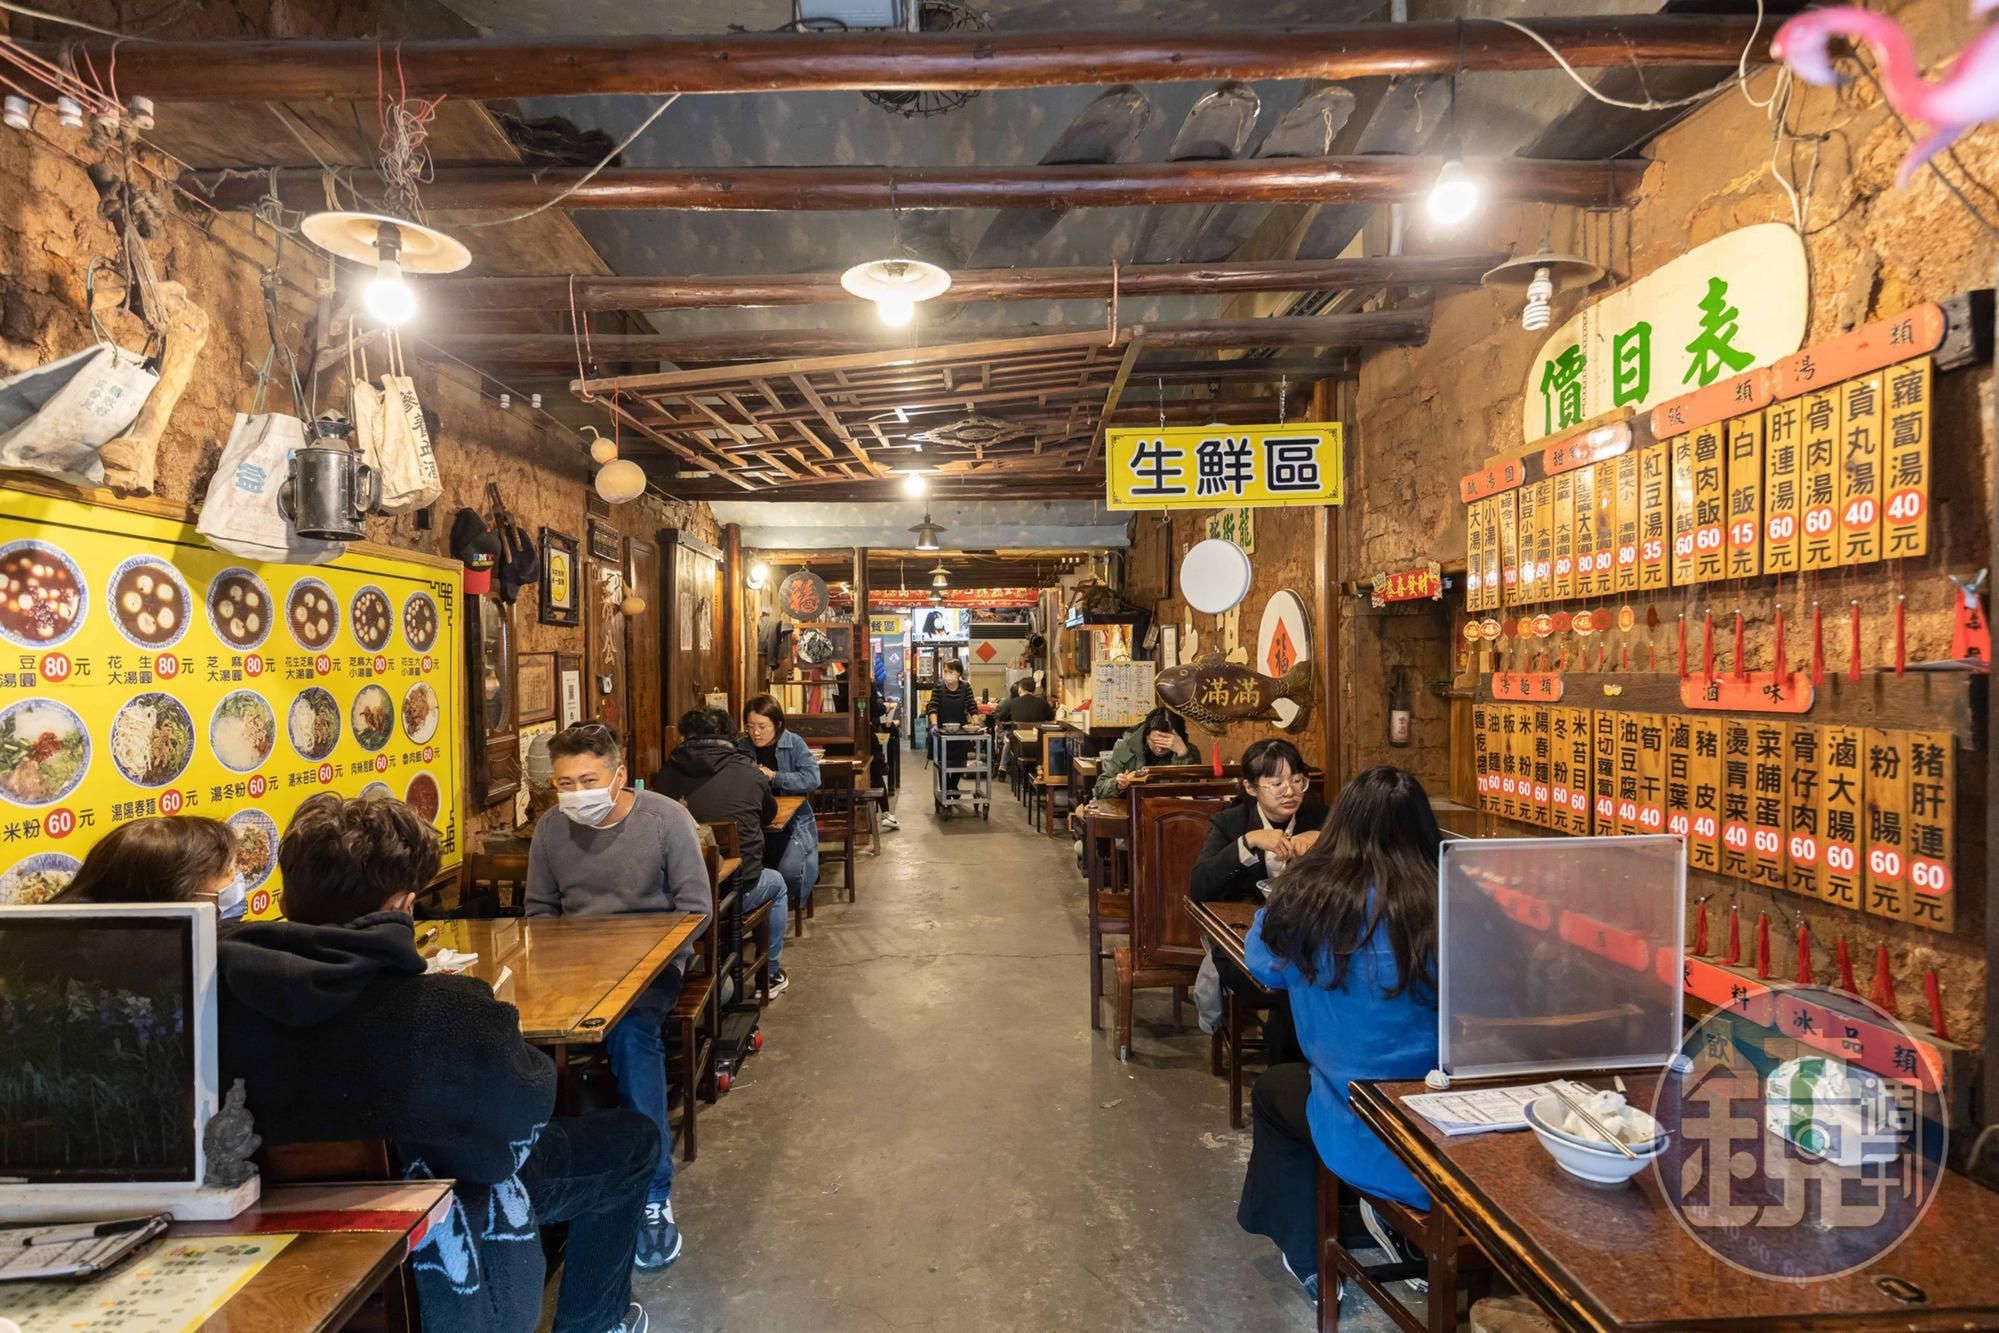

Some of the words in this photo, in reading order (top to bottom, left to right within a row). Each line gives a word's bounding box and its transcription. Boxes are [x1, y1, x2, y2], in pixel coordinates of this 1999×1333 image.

[1540, 277, 1756, 436] 價目表
[1795, 319, 1914, 382] 湯類
[1890, 368, 1924, 489] 蘿蔔湯
[1806, 399, 1833, 507] 骨肉湯
[1846, 386, 1875, 498] 貢丸湯
[1130, 438, 1320, 495] 生鮮區
[1770, 409, 1796, 512] 肝連湯
[1695, 433, 1720, 526] 魯肉飯
[1732, 432, 1755, 516] 白飯
[1644, 454, 1662, 538] 紅豆湯
[1888, 493, 1920, 518] 40
[1806, 509, 1831, 532] 60
[1846, 500, 1873, 524] 40
[1698, 528, 1720, 548] 60
[1732, 523, 1753, 545] 15
[1769, 517, 1793, 539] 60
[1891, 525, 1920, 552] 元
[1619, 547, 1634, 563] 80
[1643, 541, 1662, 559] 35
[1676, 536, 1693, 556] 60
[1807, 539, 1832, 563] 元
[1846, 532, 1872, 558] 元
[1557, 559, 1570, 574] 80
[1579, 556, 1592, 571] 80
[1597, 553, 1611, 569] 80
[1700, 554, 1720, 576] 元
[1733, 552, 1753, 575] 元
[1770, 545, 1792, 568] 元
[1597, 574, 1610, 591] 元
[1620, 568, 1634, 586] 元
[1644, 564, 1661, 584] 元
[1557, 580, 1569, 597] 元
[1580, 577, 1592, 594] 元
[19, 656, 36, 669] 豆
[44, 657, 67, 677] 80
[75, 658, 91, 676] 元
[158, 657, 176, 675] 80
[181, 658, 194, 674] 元
[246, 657, 261, 673] 80
[265, 658, 275, 673] 元
[317, 657, 330, 672] 80
[332, 658, 341, 672] 元
[375, 657, 385, 671] 80
[387, 658, 395, 671] 元
[423, 658, 432, 670] 80
[108, 672, 153, 685] 大湯圓
[207, 669, 243, 682] 大湯圓
[285, 669, 314, 680] 大湯圓
[1201, 677, 1260, 707] 滿滿
[424, 748, 432, 760] 60
[1535, 712, 1549, 784] 陽春麵
[1573, 715, 1587, 791] 米苔目
[1597, 717, 1614, 798] 白切蘿蔔
[377, 757, 386, 769] 60
[389, 755, 396, 767] 元
[1620, 720, 1637, 801] 油豆腐
[1640, 727, 1662, 801] 筍干
[1669, 723, 1689, 810] 滷百葉
[1695, 730, 1718, 811] 豬皮
[319, 766, 332, 781] 60
[335, 765, 344, 778] 元
[1489, 776, 1500, 789] 60
[1726, 727, 1748, 822] 燙青菜
[1755, 730, 1781, 828] 菜脯蛋
[1791, 732, 1818, 835] 骨仔肉
[211, 781, 245, 803] 湯冬粉
[250, 777, 264, 795] 60
[268, 776, 279, 791] 元
[1503, 779, 1515, 792] 60
[1518, 782, 1531, 796] 60
[1535, 787, 1547, 801] 60
[1554, 788, 1567, 803] 60
[1827, 736, 1857, 844] 滷大腸
[1870, 745, 1901, 846] 粉腸
[111, 798, 156, 822] 湯陽春麵
[162, 793, 180, 811] 60
[185, 790, 198, 807] 元
[1490, 796, 1500, 811] 元
[1504, 800, 1515, 816] 元
[1519, 803, 1531, 820] 元
[1572, 795, 1585, 810] 60
[1597, 800, 1612, 816] 40
[1619, 804, 1636, 821] 40
[1911, 743, 1946, 860] 豬肝連
[3, 818, 41, 842] 米粉
[49, 814, 71, 833] 60
[79, 808, 95, 828] 元
[1555, 810, 1568, 828] 元
[1572, 816, 1586, 833] 元
[1640, 809, 1660, 826] 40
[1670, 816, 1688, 834] 40
[1695, 818, 1715, 836] 40
[1725, 826, 1747, 846] 40
[1754, 831, 1778, 852] 60
[1696, 844, 1714, 866] 元
[1791, 838, 1816, 860] 60
[1827, 846, 1854, 870] 60
[1726, 851, 1746, 874] 元
[1756, 858, 1778, 882] 元
[1871, 851, 1899, 876] 60
[1793, 866, 1816, 892] 元
[1912, 862, 1944, 889] 60
[1828, 875, 1853, 902] 元
[1872, 885, 1900, 914] 元
[253, 894, 266, 911] 60
[1914, 893, 1944, 922] 元
